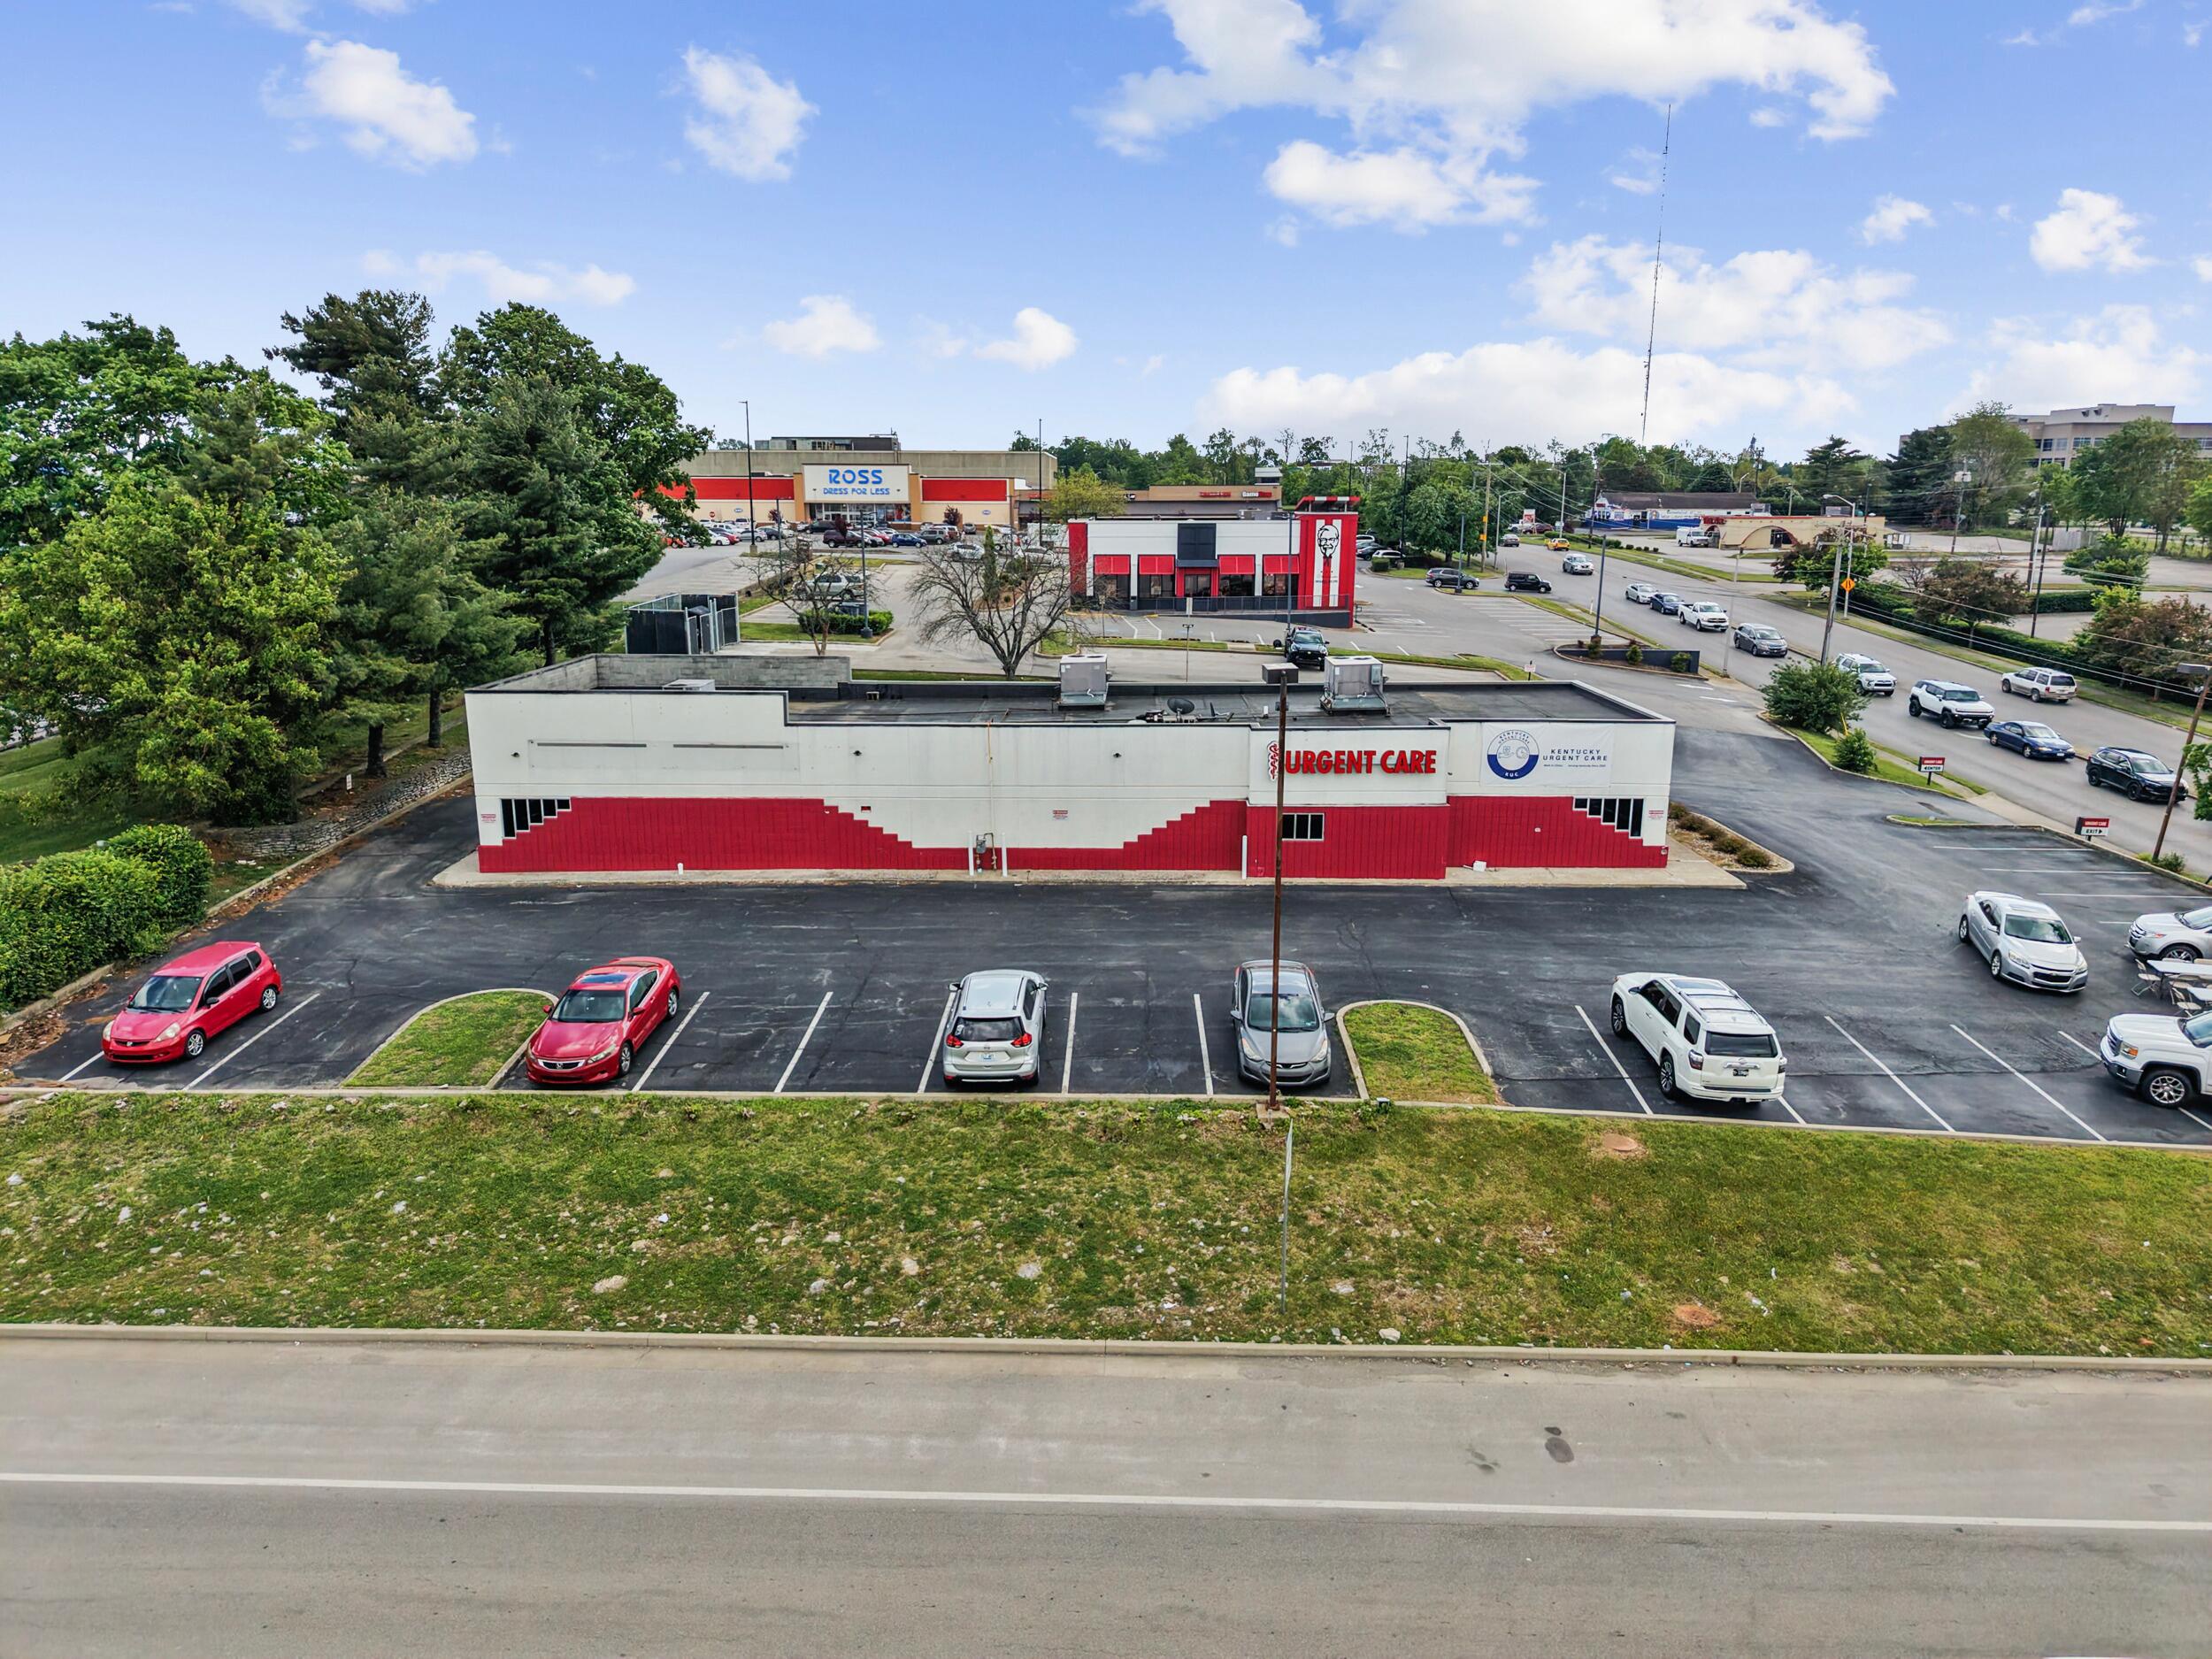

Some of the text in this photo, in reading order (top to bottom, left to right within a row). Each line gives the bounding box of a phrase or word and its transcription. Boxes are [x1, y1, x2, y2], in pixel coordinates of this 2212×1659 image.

[828, 469, 883, 485] ROSS
[1284, 749, 1437, 774] URGENT CARE
